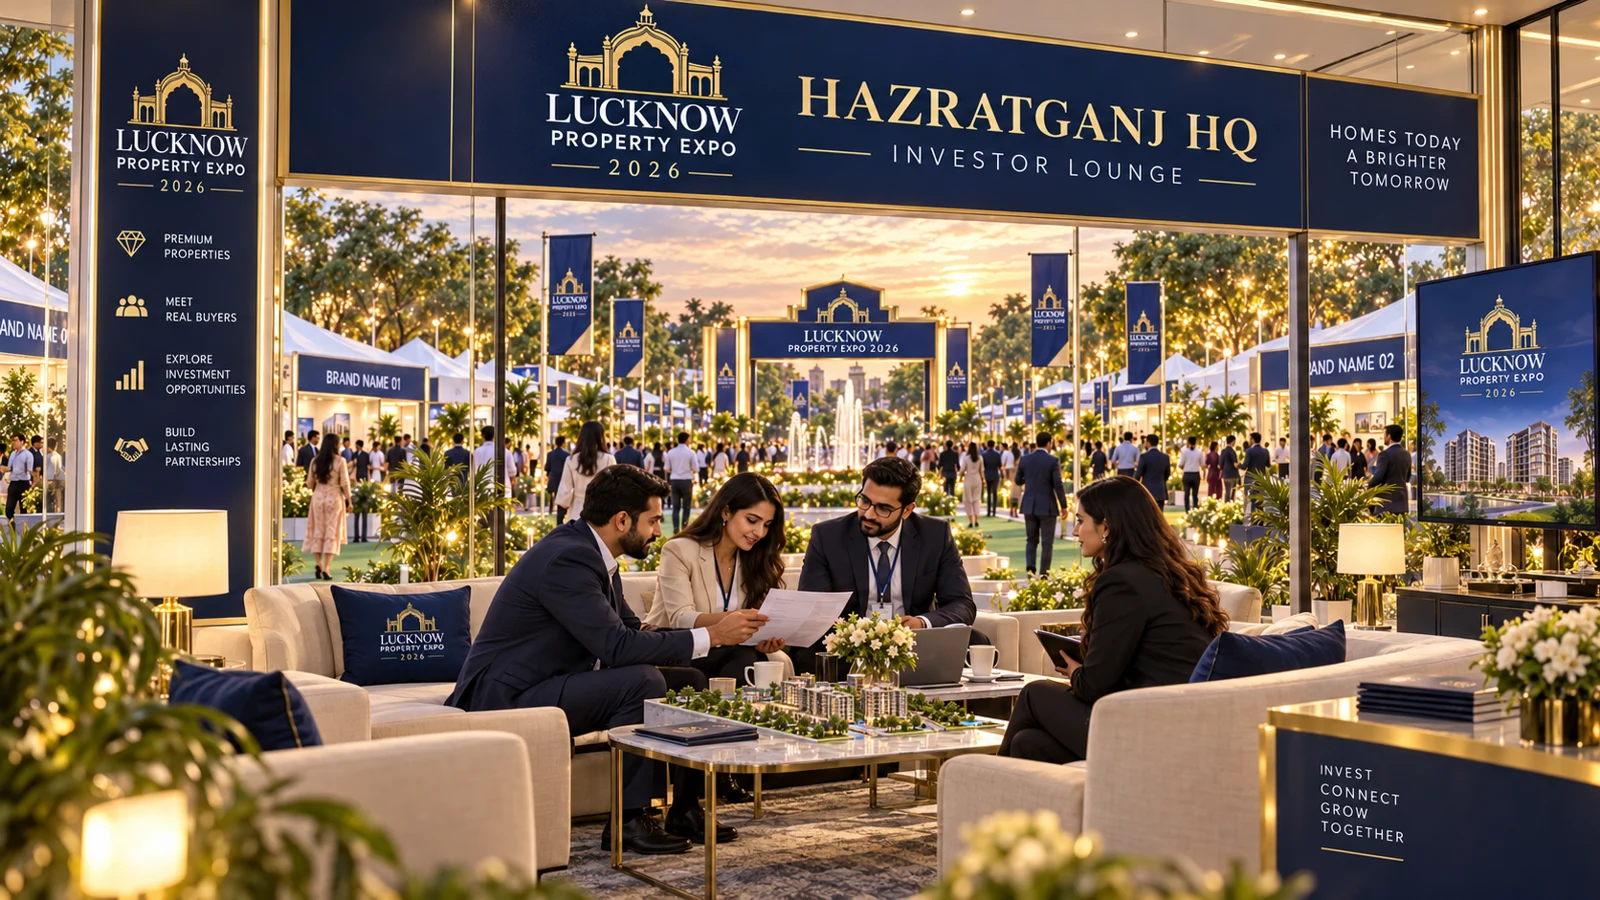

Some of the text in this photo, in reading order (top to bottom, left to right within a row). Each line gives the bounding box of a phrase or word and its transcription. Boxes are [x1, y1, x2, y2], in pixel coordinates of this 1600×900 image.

[546, 93, 743, 133] LUCKNOW
[798, 76, 1257, 162] HAZRATGANJ HQ
[117, 129, 248, 158] LUCKNOW
[552, 130, 736, 156] PROPERTY EXPO
[1331, 124, 1460, 150] HOMES TODAY
[117, 157, 245, 176] PROPERTY EXPO
[894, 145, 1181, 184] INVESTOR LOUNGE
[1347, 149, 1445, 170] A BRIGHTER
[609, 159, 679, 178] 2026
[161, 179, 204, 193] 2026
[1350, 172, 1449, 191] TOMORROW
[165, 234, 212, 244] PREMIUM
[165, 249, 230, 260] PROPERTIES
[166, 297, 192, 306] MEET
[166, 312, 237, 322] REAL BUYERS
[805, 330, 882, 342] LUCKNOW
[870, 344, 898, 352] 2026
[166, 355, 212, 364] EXPLORE
[1309, 353, 1394, 376] AND NAME 02
[1460, 353, 1545, 374] LUCKNOW
[166, 370, 230, 379] INVESTMENT
[327, 370, 400, 390] BRAND NAME 01
[1460, 372, 1544, 385] PROPERTY EXPO
[166, 385, 245, 394] OPPORTUNITIES
[1486, 388, 1515, 398] 2026
[166, 427, 195, 437] BUILD
[166, 442, 209, 452] LASTING
[166, 457, 241, 466] PARTNERSHIPS
[380, 633, 444, 645] LUCKNOW
[1321, 765, 1372, 780] INVEST
[1321, 783, 1399, 806] CONNECT
[1321, 802, 1368, 819] GROW
[1321, 821, 1403, 843] TOGETHER
